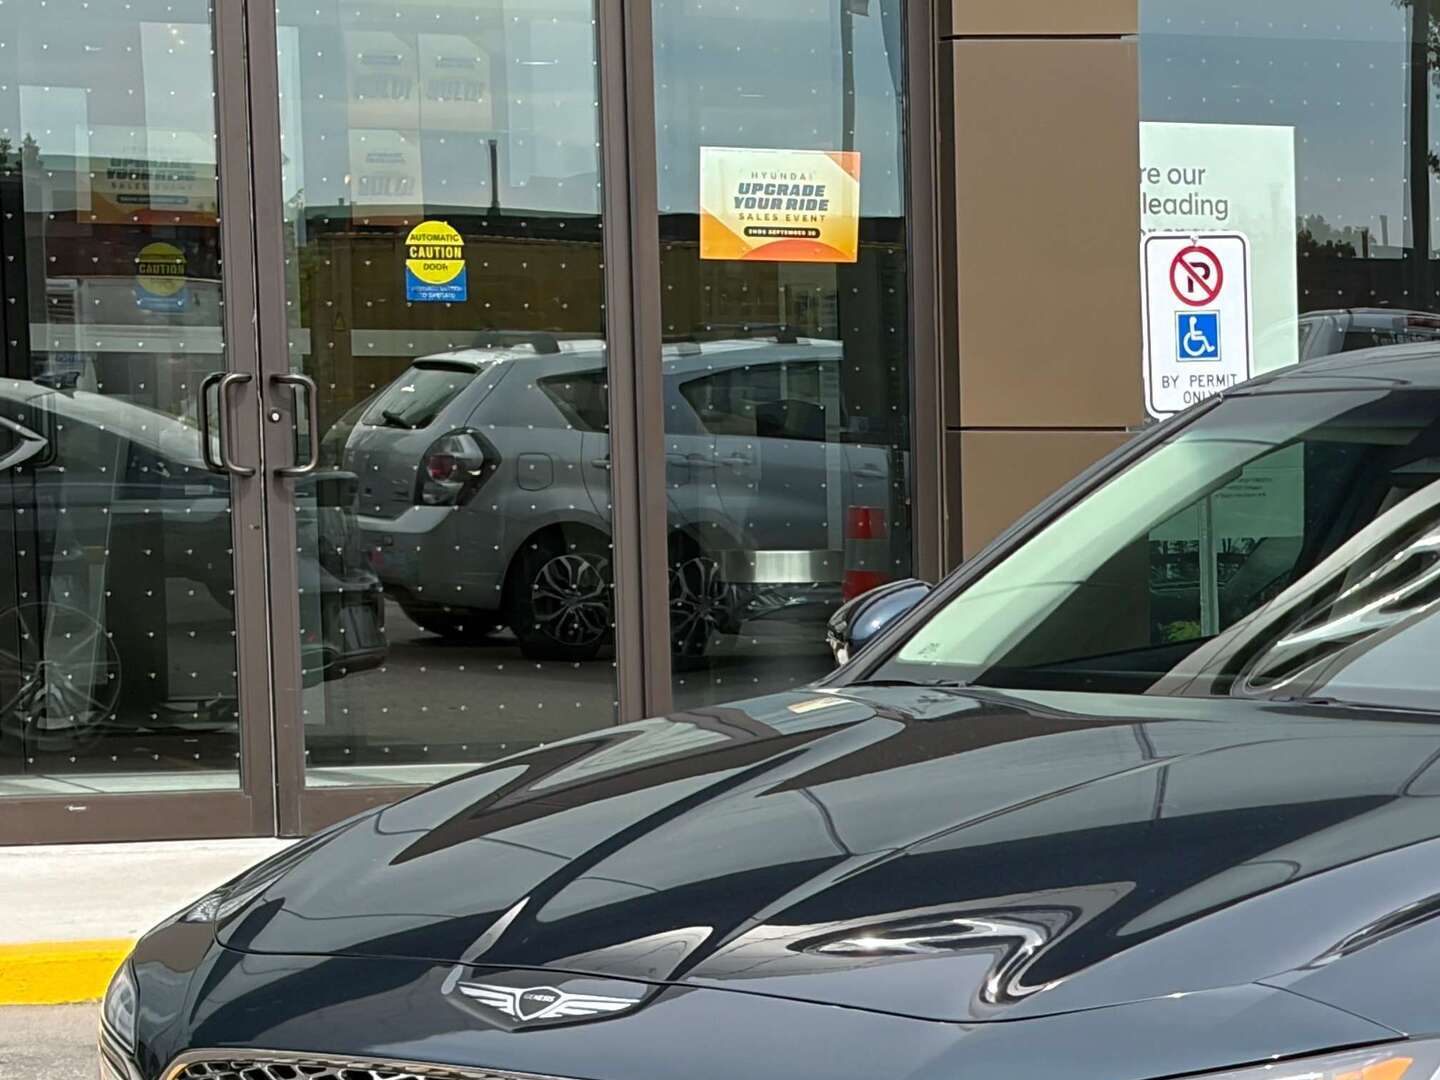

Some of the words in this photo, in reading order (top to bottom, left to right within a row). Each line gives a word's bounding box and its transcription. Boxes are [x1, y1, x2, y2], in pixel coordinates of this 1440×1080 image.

[751, 171, 813, 180] HYUNDAI
[1167, 167, 1206, 185] our
[738, 183, 826, 197] UPGRADE
[733, 196, 783, 210] YOUR
[785, 198, 830, 211] RIDE
[1142, 192, 1229, 221] leading
[738, 213, 779, 221] SALES
[785, 214, 826, 223] EVENT
[410, 233, 460, 242] AUTOMATIC
[409, 246, 462, 258] CAUTION
[423, 263, 448, 271] DOOR
[1161, 375, 1180, 389] BY
[1189, 374, 1237, 388] PERMIT
